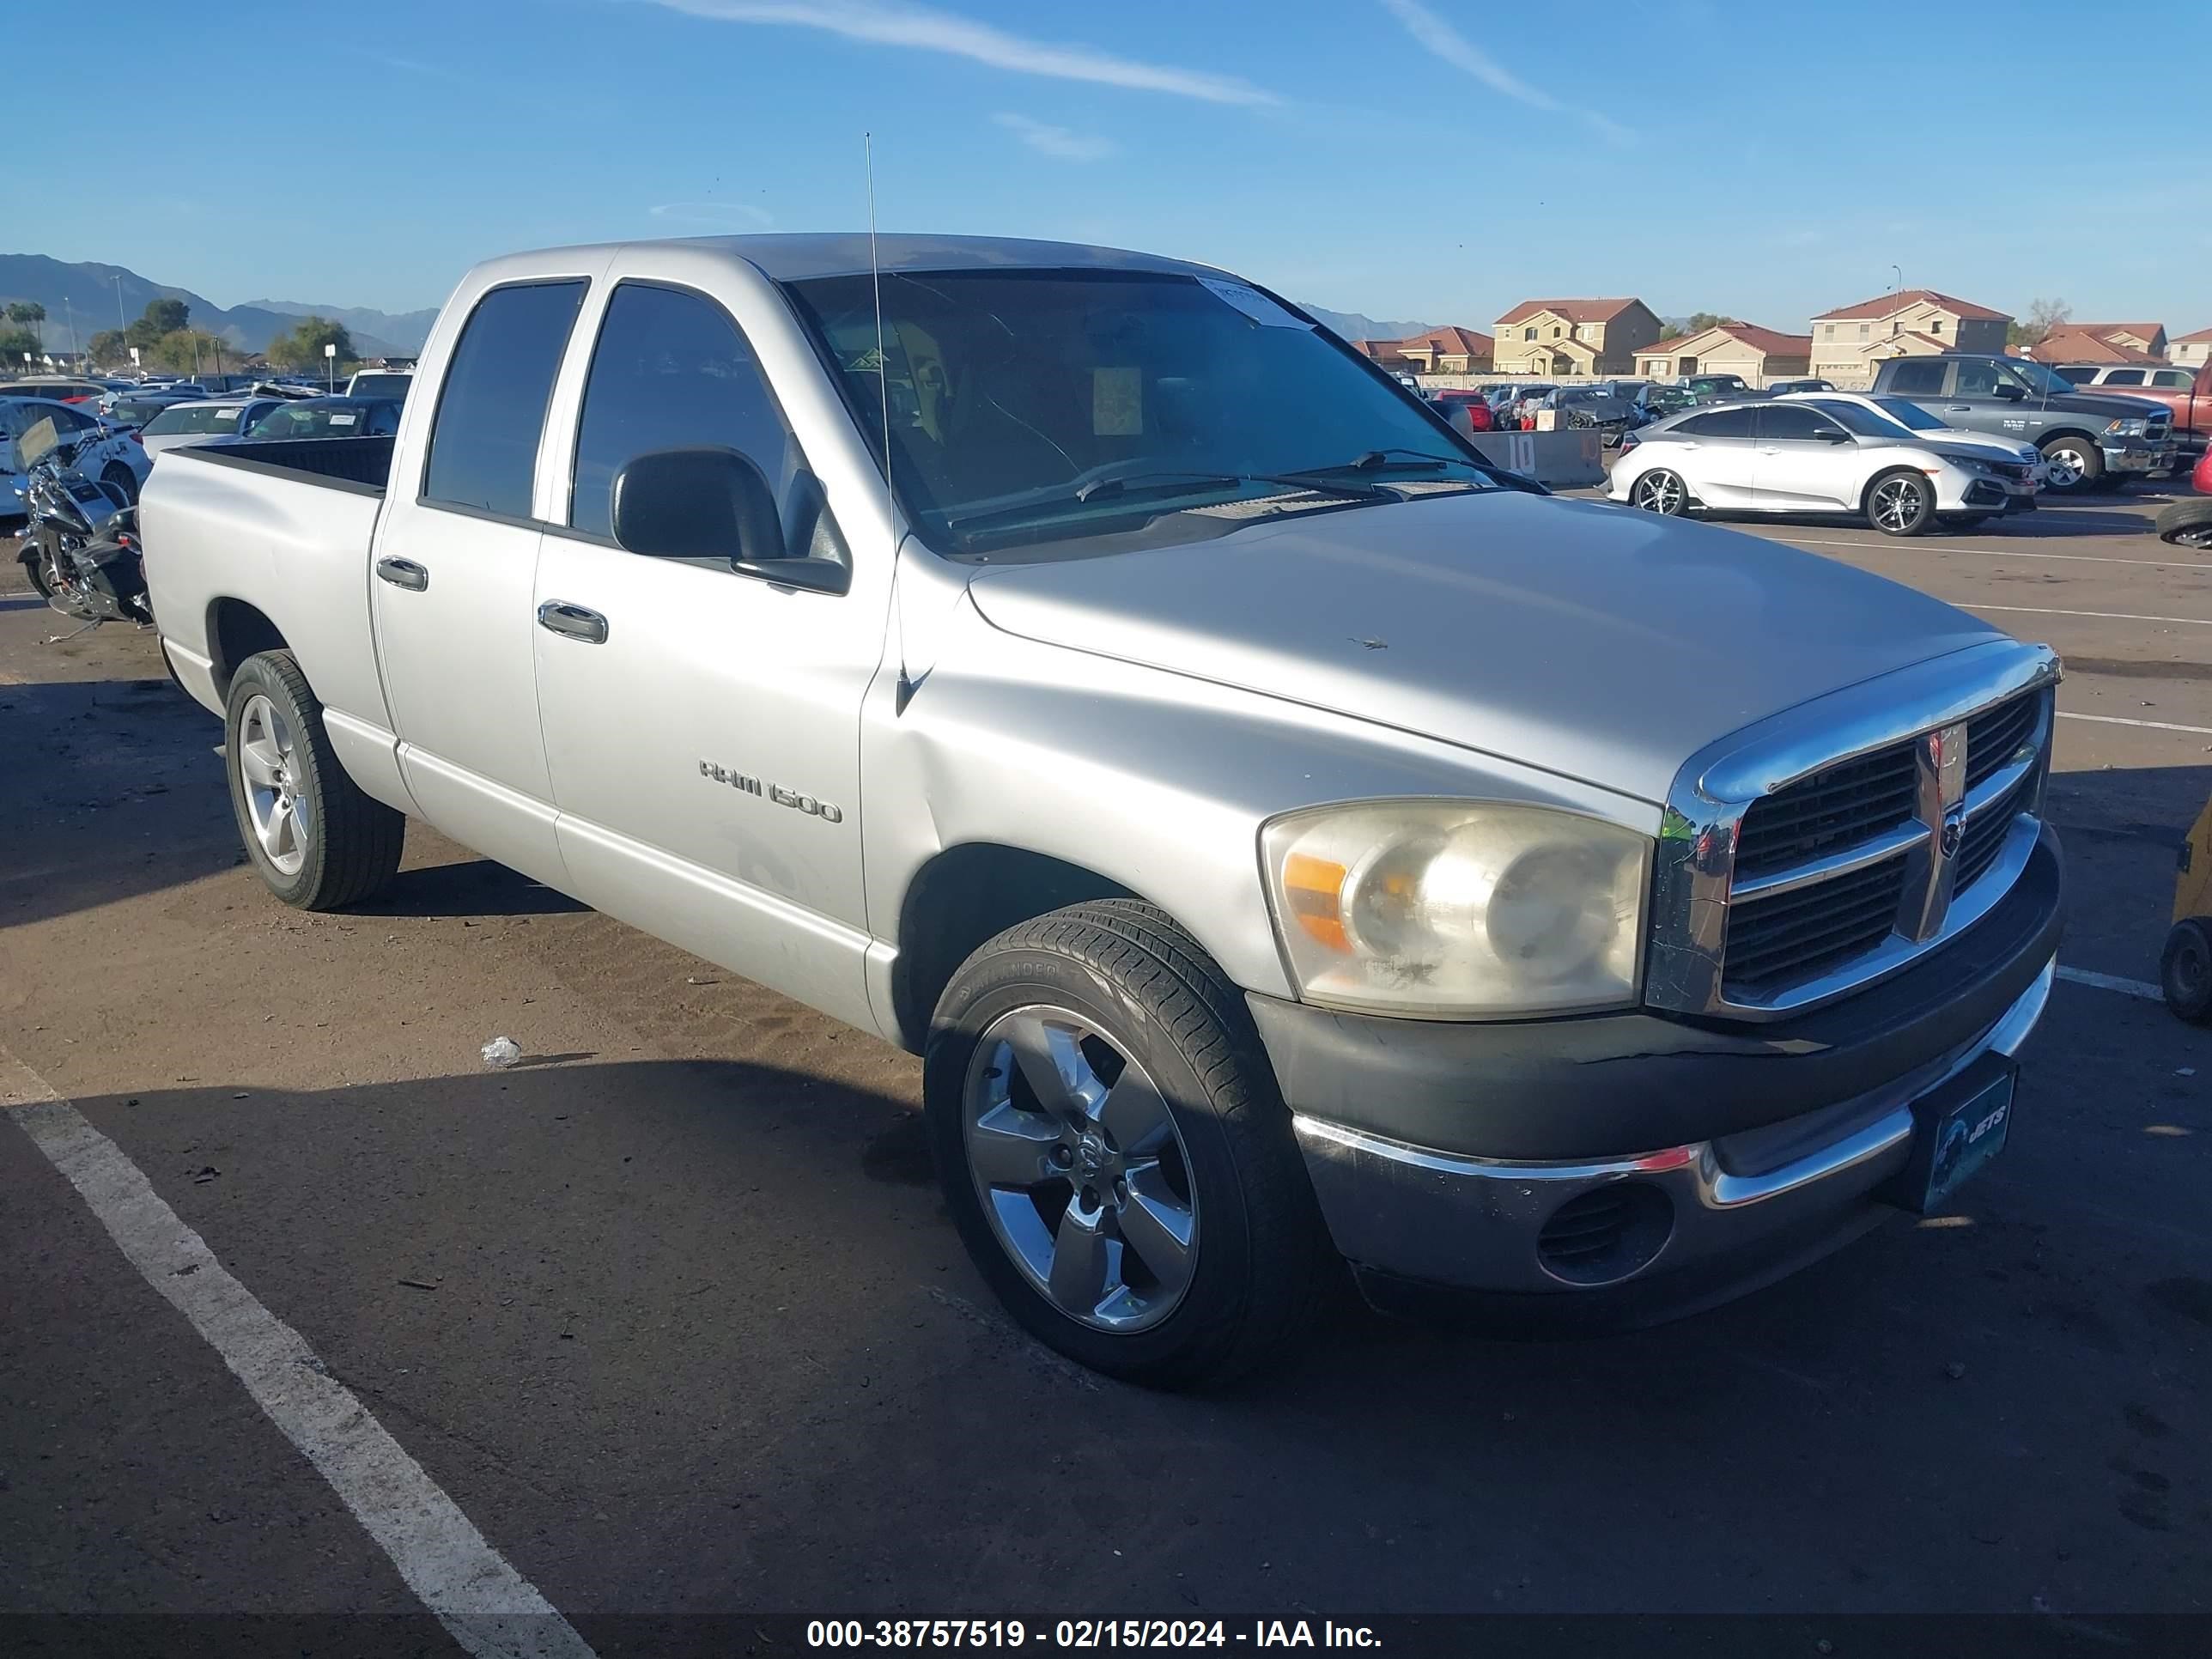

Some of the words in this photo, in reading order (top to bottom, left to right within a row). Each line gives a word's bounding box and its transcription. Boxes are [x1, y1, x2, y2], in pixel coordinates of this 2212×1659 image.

[1509, 434, 1535, 475] 10
[699, 758, 763, 797] RAM
[769, 782, 843, 823] 1500
[1968, 1105, 2007, 1145] JETS
